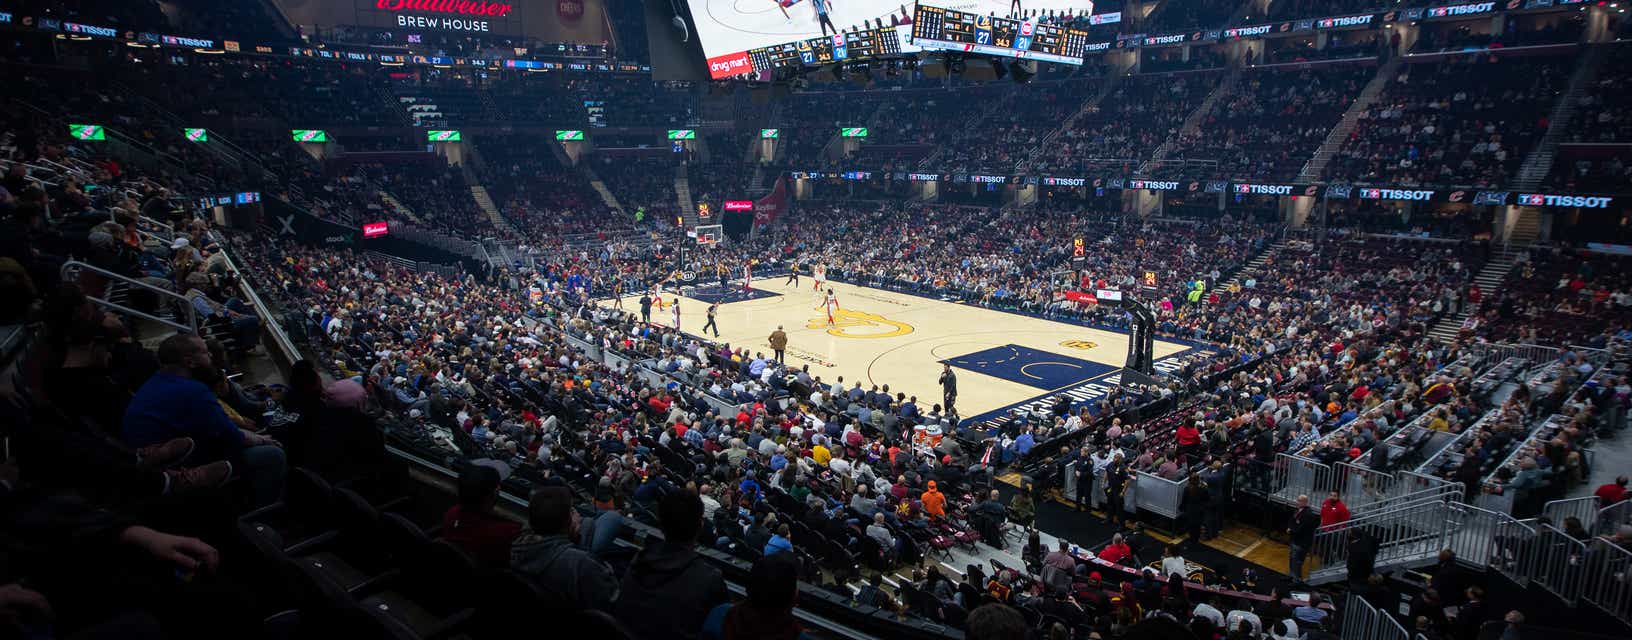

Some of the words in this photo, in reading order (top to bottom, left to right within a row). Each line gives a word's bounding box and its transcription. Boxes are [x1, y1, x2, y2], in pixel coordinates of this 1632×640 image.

[1445, 2, 1496, 16] TISSOT
[397, 15, 438, 28] BREW
[442, 18, 489, 32] HOUSE
[1333, 14, 1374, 26] TISSOT
[80, 25, 117, 37] TISSOT
[1238, 25, 1272, 36] TISSOT
[176, 37, 214, 48] TISSOT
[977, 32, 989, 44] 27
[996, 38, 1010, 48] 34.3
[1018, 38, 1026, 49] 21
[1155, 35, 1185, 45] TISSOT
[802, 53, 813, 63] 27
[837, 48, 847, 58] 21
[711, 60, 730, 73] drug
[730, 56, 749, 69] mart
[981, 175, 1006, 184] TISSOT
[1055, 178, 1085, 187] TISSOT
[1143, 180, 1179, 190] TISSOT
[1250, 184, 1293, 195] TISSOT
[1380, 189, 1435, 201] TISSOT
[1543, 196, 1613, 209] TISSOT
